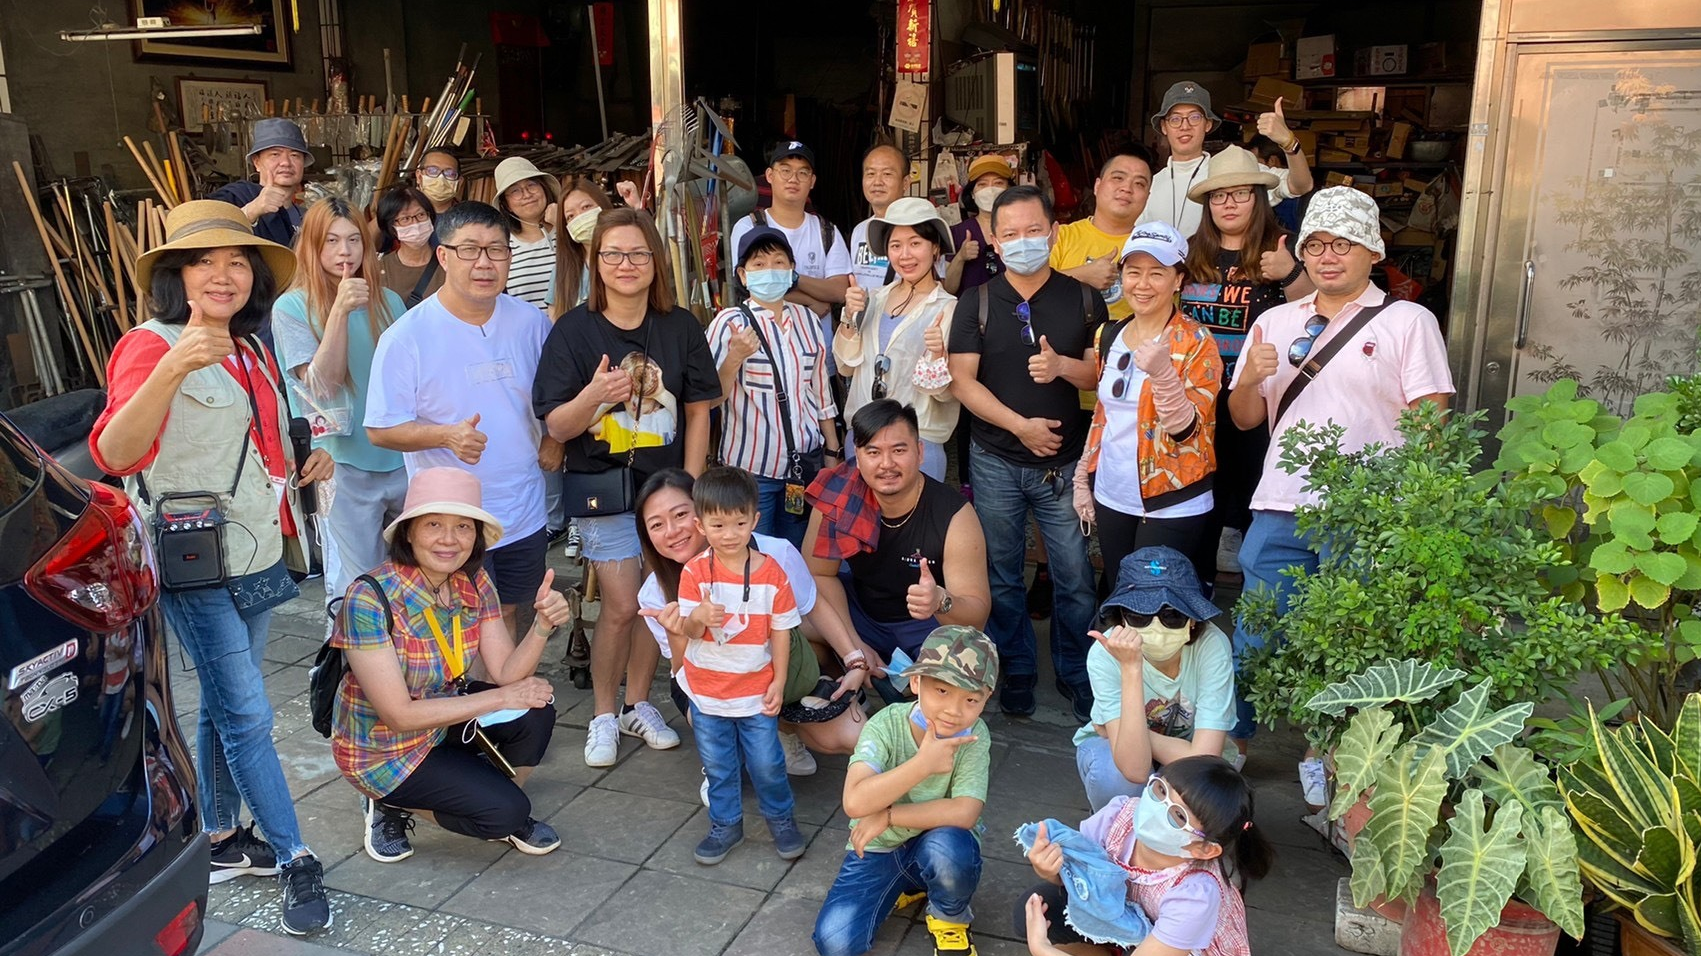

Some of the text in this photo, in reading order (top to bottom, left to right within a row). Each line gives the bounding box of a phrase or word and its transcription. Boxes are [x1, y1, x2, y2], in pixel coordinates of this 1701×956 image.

[1223, 286, 1252, 304] WE
[1219, 308, 1241, 328] BE
[18, 647, 64, 676] SKYACTIV
[29, 687, 77, 719] CX-5
